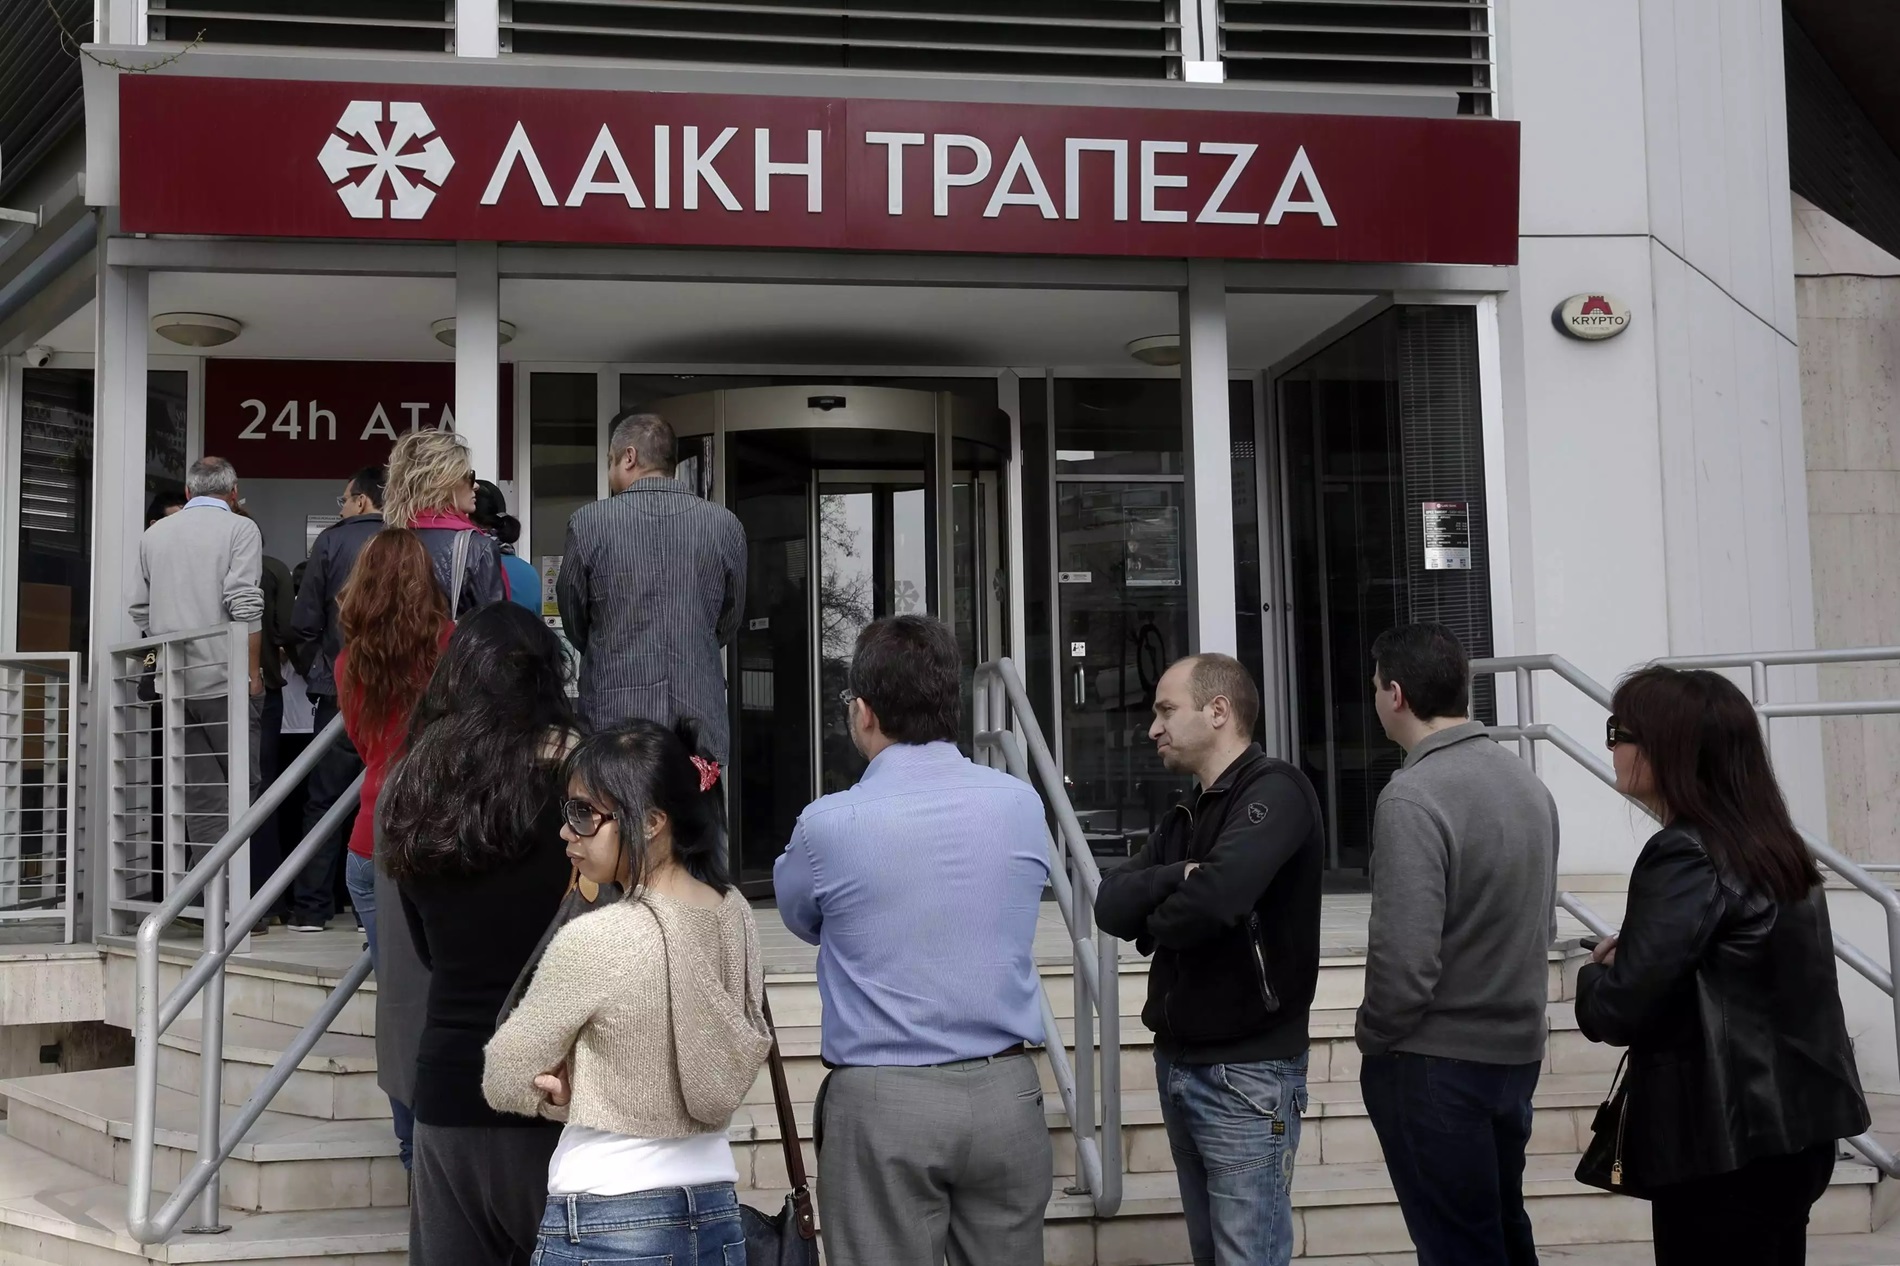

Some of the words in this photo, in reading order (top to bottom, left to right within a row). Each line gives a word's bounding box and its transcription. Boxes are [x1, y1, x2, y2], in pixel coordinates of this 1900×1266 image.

[480, 120, 822, 212] ΛΑΙΚΗ
[865, 131, 1338, 226] ΤΡΑΠΕΖΑ
[1572, 316, 1625, 325] KRYPTO
[237, 399, 337, 441] 24h
